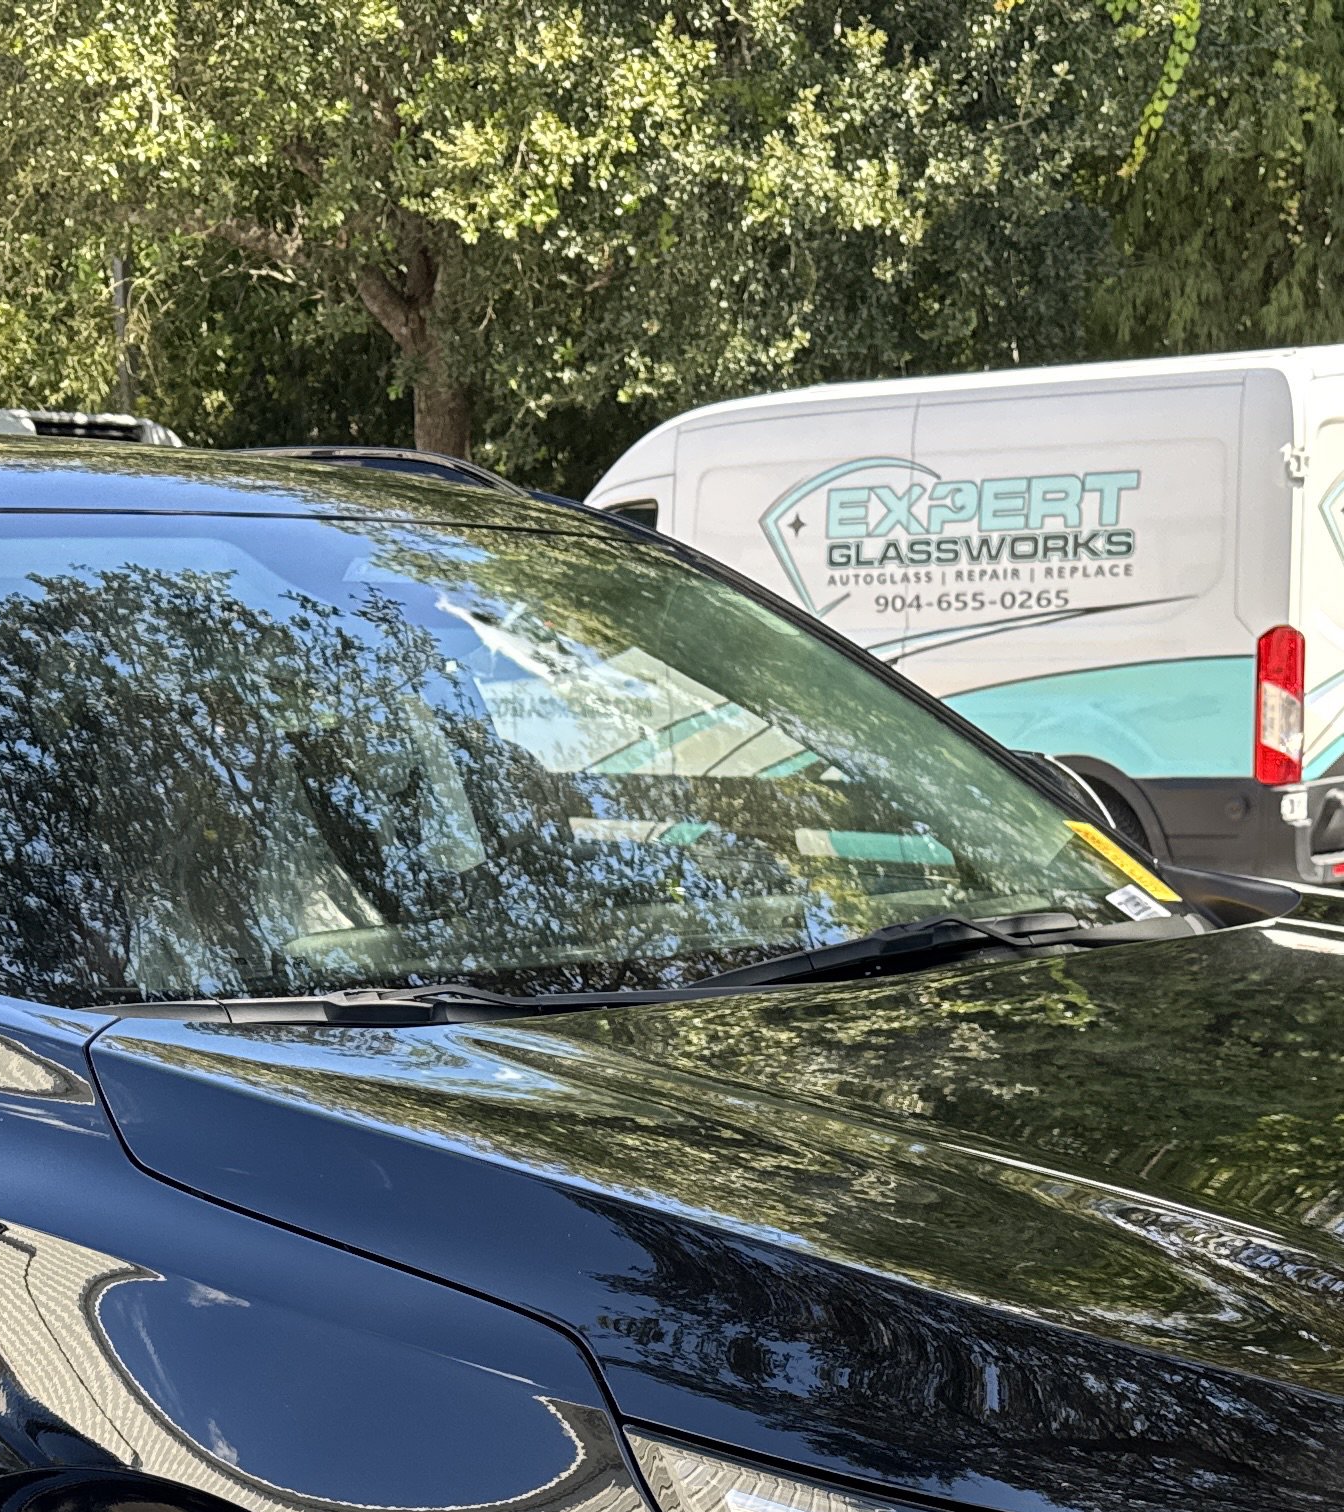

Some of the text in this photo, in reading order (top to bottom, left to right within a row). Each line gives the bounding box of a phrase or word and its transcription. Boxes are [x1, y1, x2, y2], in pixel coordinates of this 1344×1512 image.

[825, 470, 1141, 539] EXPERT
[825, 529, 1136, 569] GLASSWORKS
[827, 570, 934, 587] AUTOGLASS
[954, 567, 1021, 583] REPAIR
[1043, 563, 1135, 580] REPLACE
[874, 588, 1070, 614] 904-655-0265
